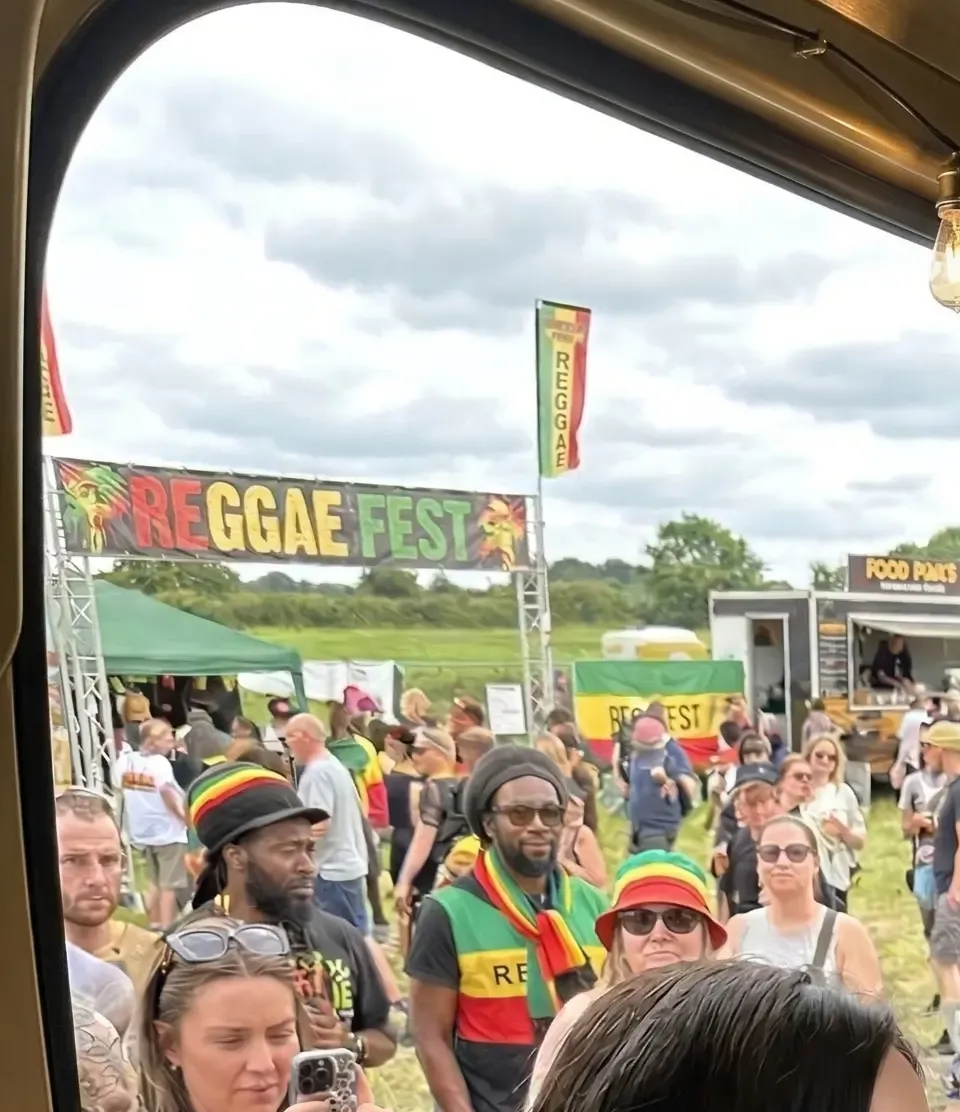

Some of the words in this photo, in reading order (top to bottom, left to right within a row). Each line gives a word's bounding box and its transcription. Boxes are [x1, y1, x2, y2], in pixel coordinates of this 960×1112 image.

[555, 351, 570, 467] REGGAE
[129, 475, 350, 557] REGGAE
[355, 493, 472, 562] FEST
[866, 557, 910, 580] FOOD
[664, 703, 700, 731] EST
